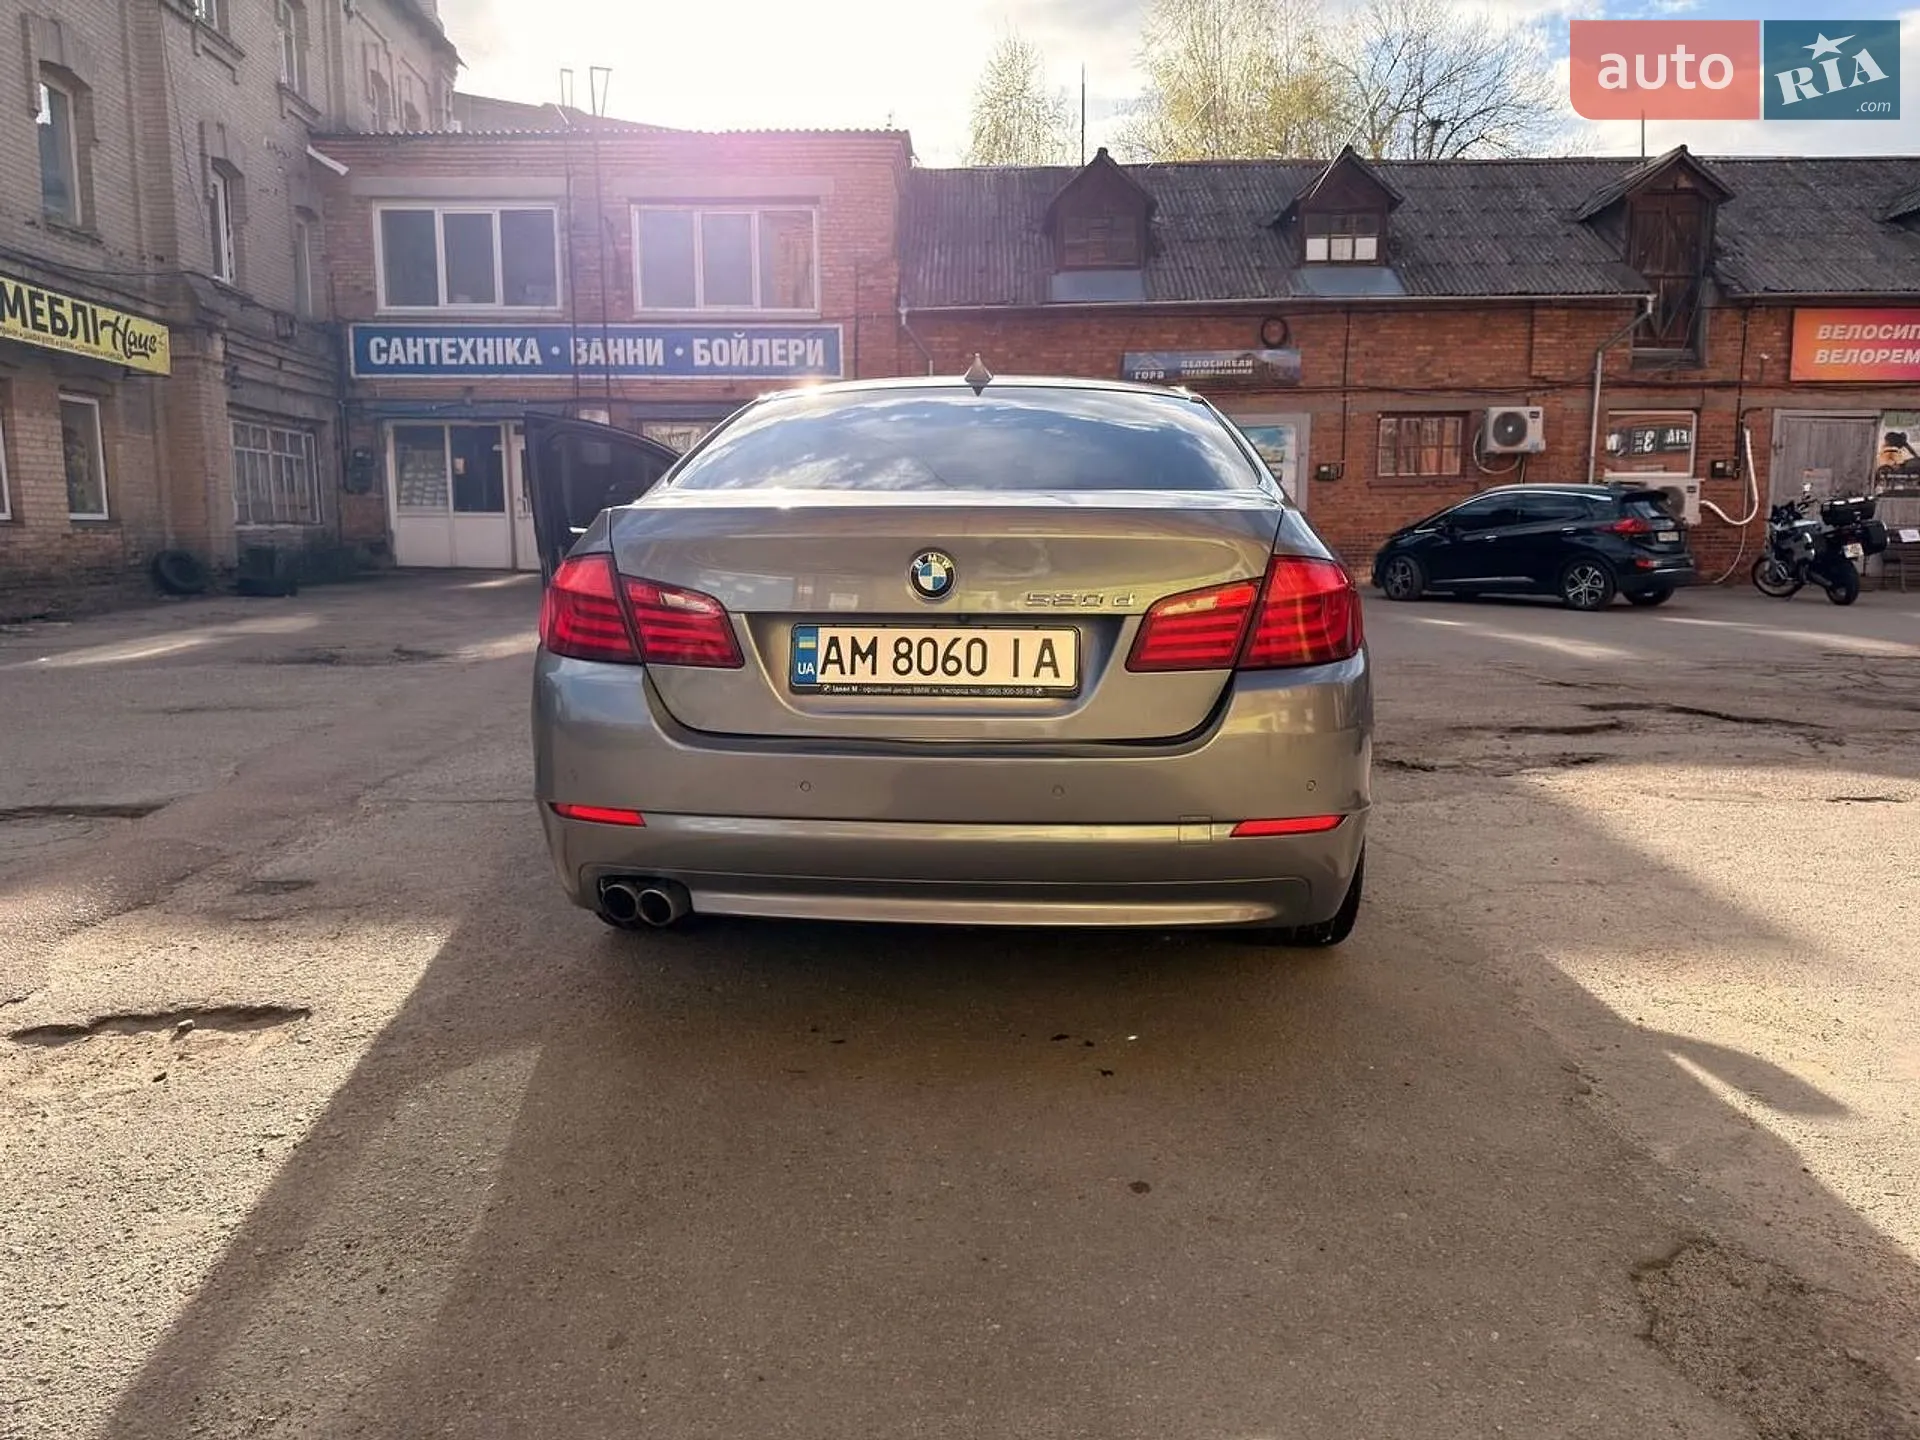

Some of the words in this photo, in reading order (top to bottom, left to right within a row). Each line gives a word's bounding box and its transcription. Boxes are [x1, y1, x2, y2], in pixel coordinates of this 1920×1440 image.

[0, 281, 100, 346] МЕБЛІ
[369, 337, 543, 365] САНТЕХНІКА
[570, 337, 664, 366] ВАННИ
[692, 332, 825, 367] БОЙЛЕРИ
[1815, 348, 1920, 364] ВЕЛОРЕМ
[798, 663, 815, 675] UA
[820, 636, 878, 676] AM
[893, 637, 988, 677] 8060
[1012, 638, 1060, 678] IA
